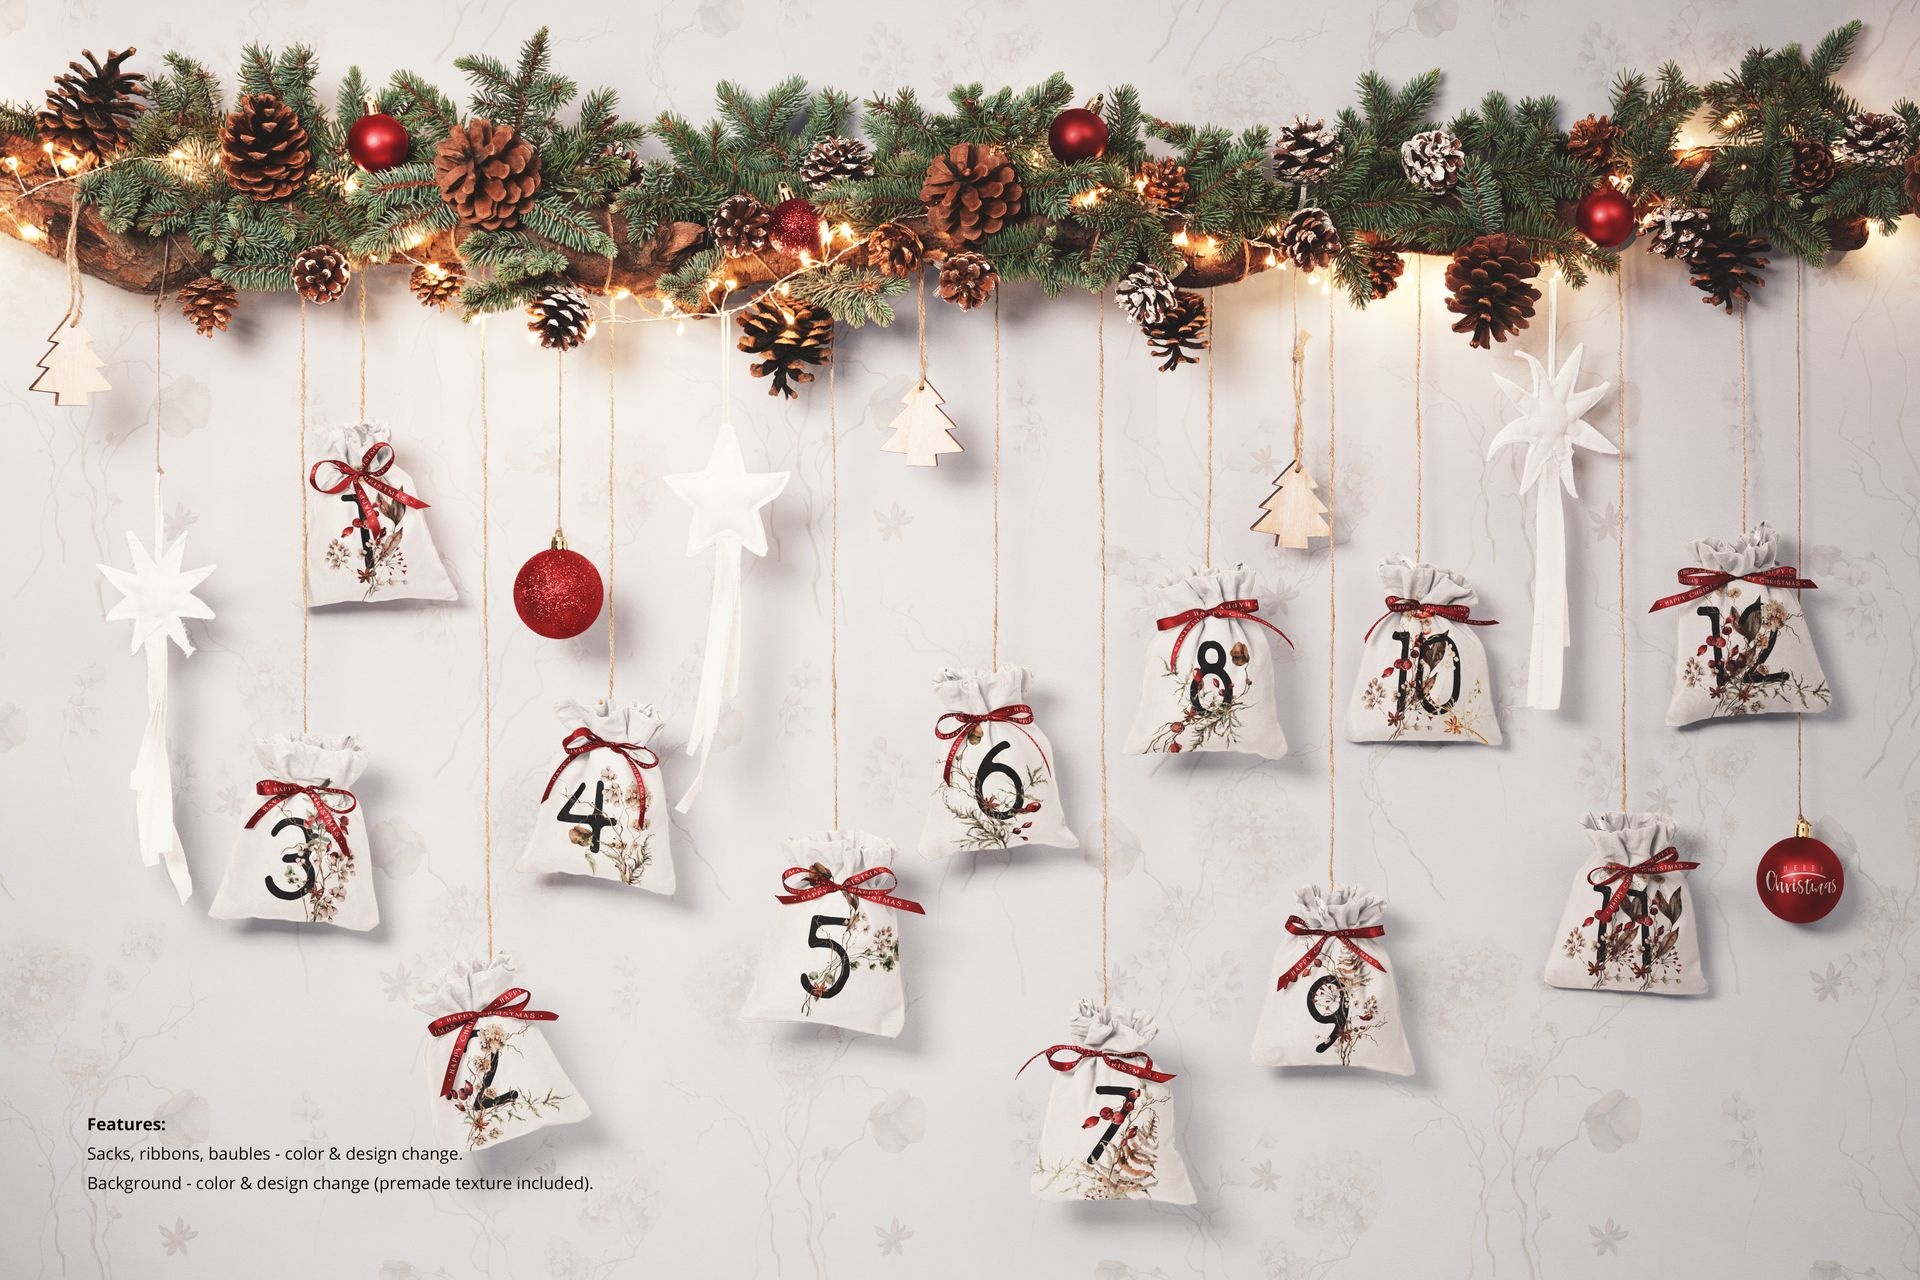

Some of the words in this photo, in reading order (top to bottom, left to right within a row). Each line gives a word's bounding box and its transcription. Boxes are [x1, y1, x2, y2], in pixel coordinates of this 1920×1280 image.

[341, 493, 375, 571] 1
[1664, 595, 1686, 606] HAPPY
[1189, 640, 1234, 716] 8
[1391, 630, 1462, 716] 10
[1697, 602, 1790, 687] 12
[557, 780, 617, 854] 4
[974, 740, 1025, 820] 6
[265, 817, 315, 900] 3
[1765, 870, 1837, 896] Christmas
[800, 914, 850, 999] 5
[1593, 885, 1652, 966] 11
[500, 989, 523, 1004] HAPPY
[1290, 954, 1312, 977] HAPPY
[446, 1012, 475, 1023] HAPPY
[1306, 974, 1350, 1054] 9
[448, 1047, 463, 1076] HAPPY
[463, 1029, 519, 1111] 2
[1086, 1085, 1138, 1165] 7
